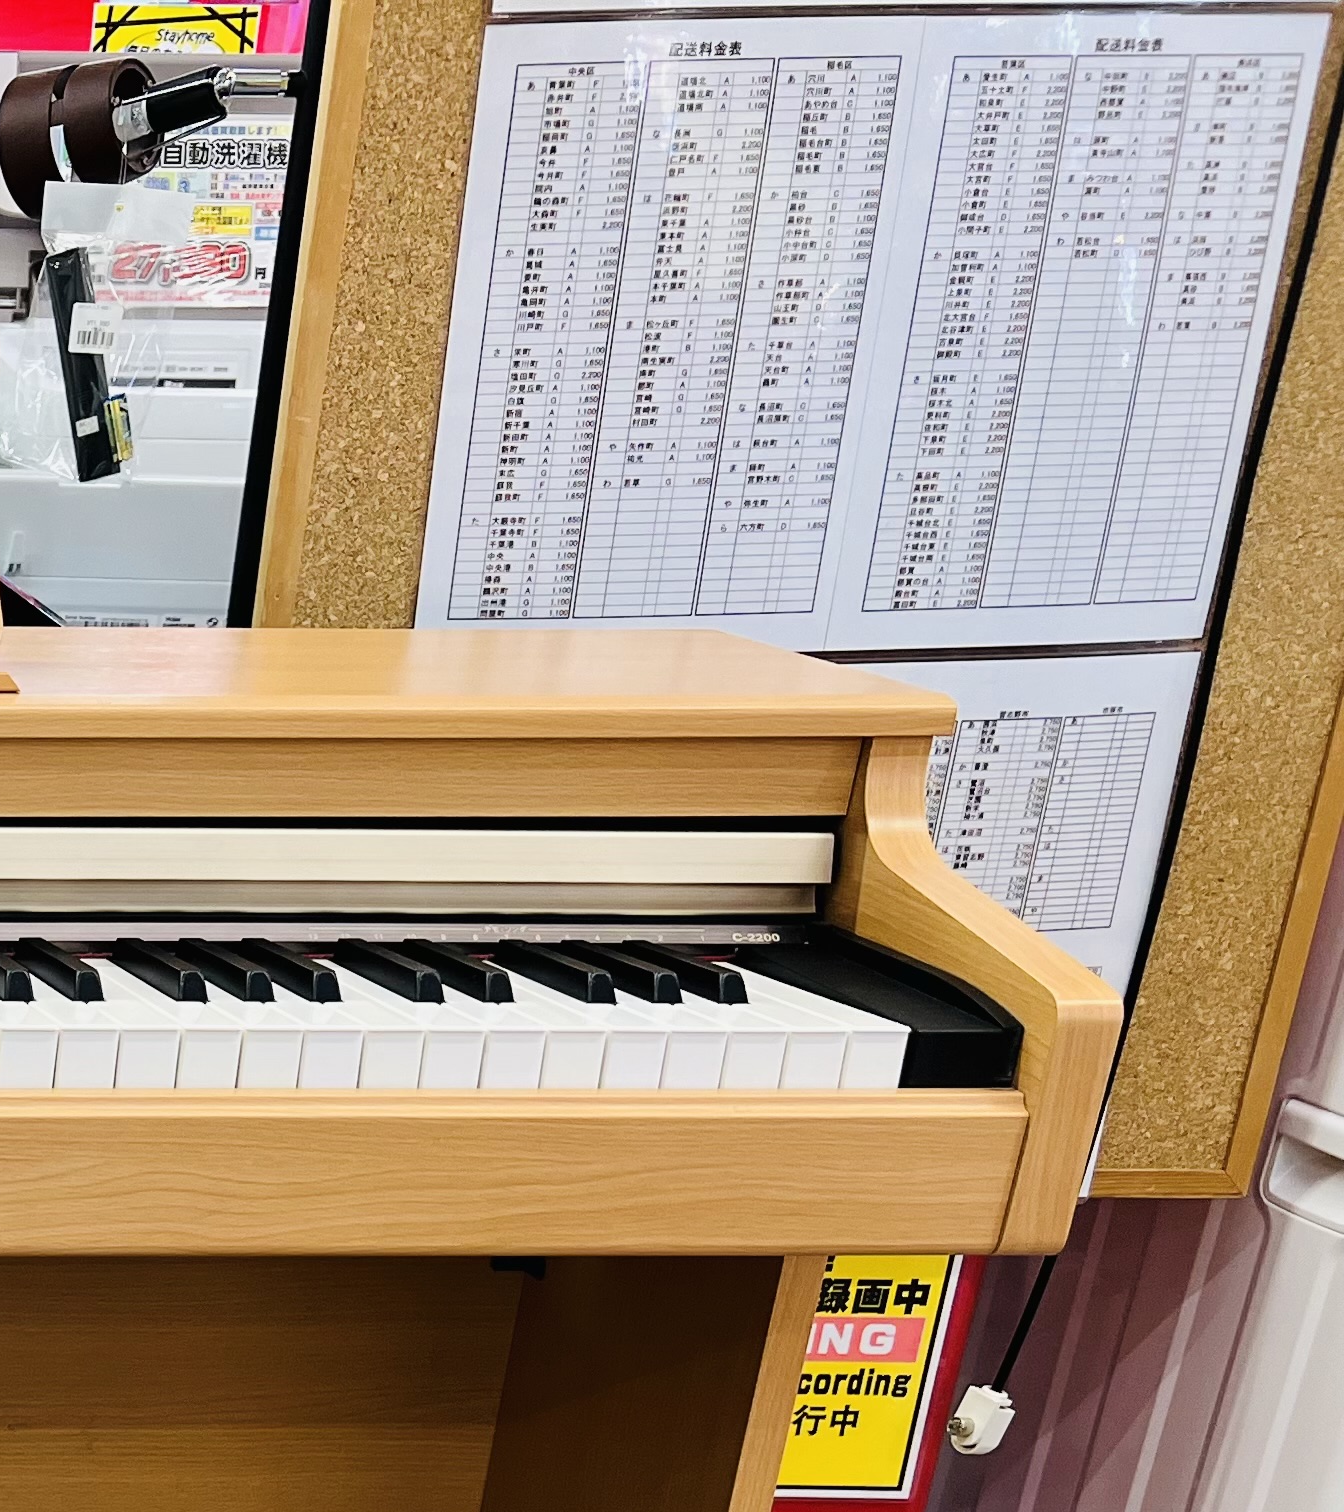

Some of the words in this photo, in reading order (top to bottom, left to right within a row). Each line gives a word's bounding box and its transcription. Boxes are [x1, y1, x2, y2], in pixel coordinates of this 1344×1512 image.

[155, 28, 216, 46] Stayhome
[669, 41, 742, 57] 配送料金表
[568, 66, 595, 76] 中央区
[807, 74, 825, 83] 穴川
[851, 74, 856, 82] A
[878, 73, 897, 82] 1,100
[849, 87, 854, 95] A
[876, 86, 895, 95] 1,100
[254, 267, 267, 281] 円
[731, 932, 781, 943] C-2200
[816, 1277, 932, 1316] 録画中
[798, 1368, 913, 1398] cording
[792, 1403, 860, 1437] 行中
